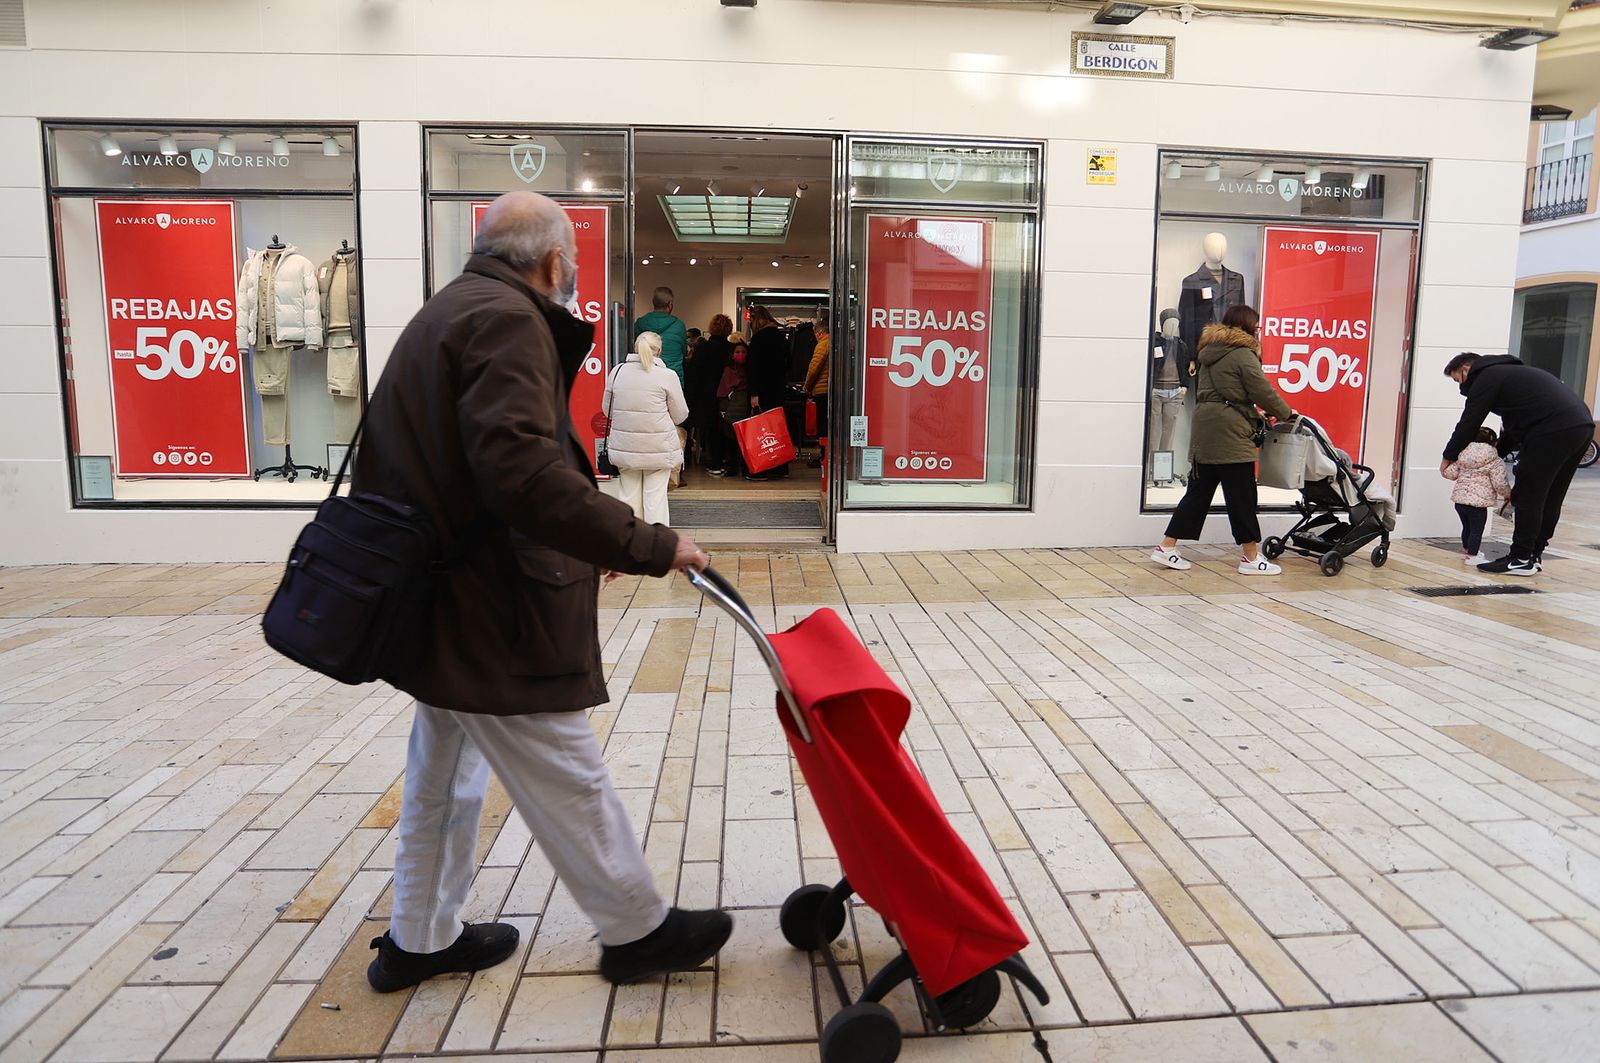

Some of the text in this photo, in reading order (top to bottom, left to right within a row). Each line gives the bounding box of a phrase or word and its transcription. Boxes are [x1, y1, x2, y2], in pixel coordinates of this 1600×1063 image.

[1108, 43, 1136, 52] CALLE
[121, 154, 188, 167] ALVARO
[217, 155, 290, 167] MORENO
[519, 149, 537, 170] A
[1218, 182, 1275, 195] ALVARO
[1301, 186, 1363, 198] MORENO
[115, 217, 155, 225] ALVARO
[172, 217, 216, 225] MORENO
[884, 231, 921, 239] ALVARO
[1279, 242, 1313, 251] ALVARO
[1327, 245, 1364, 253] MORENO
[111, 298, 233, 320] REBAJAS
[871, 308, 986, 331] REBAJAS
[1264, 317, 1367, 339] REBAJAS
